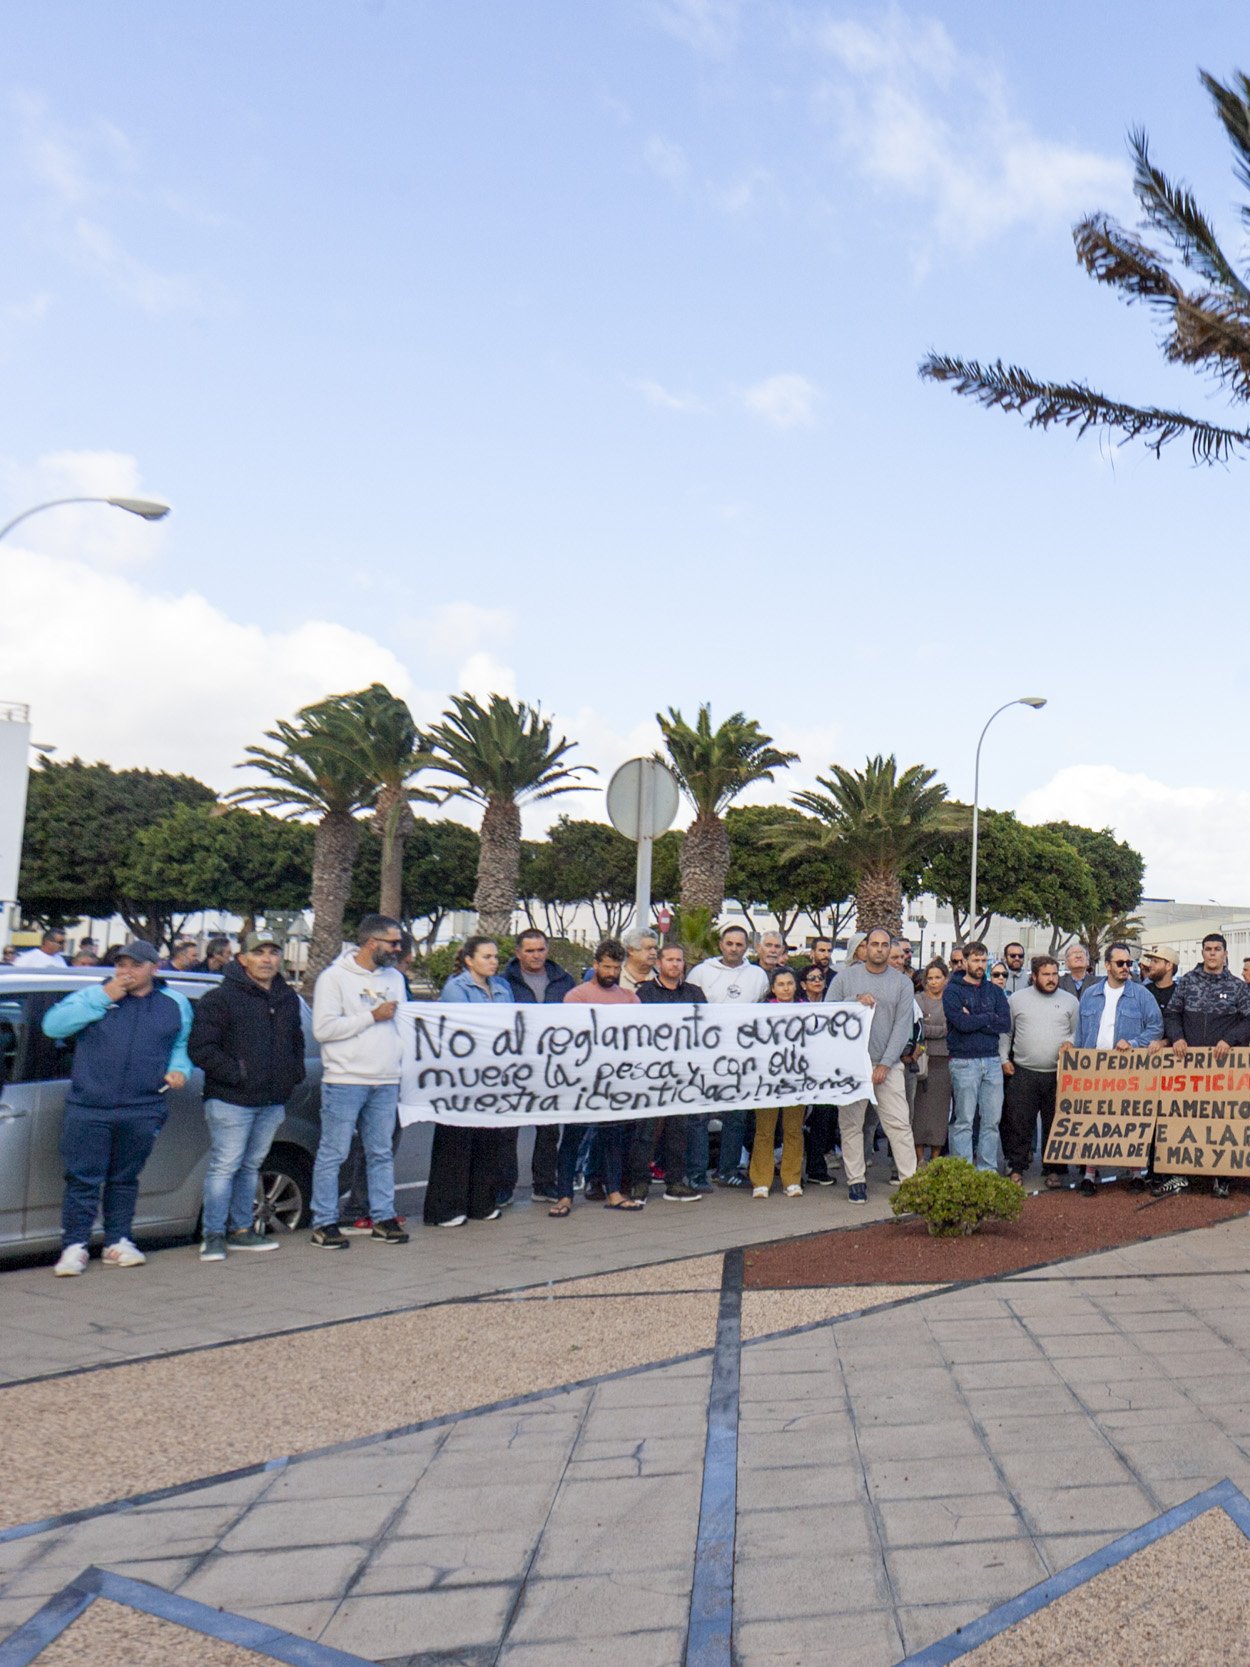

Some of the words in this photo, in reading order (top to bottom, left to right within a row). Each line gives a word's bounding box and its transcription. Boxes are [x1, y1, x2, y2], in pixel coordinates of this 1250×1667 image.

[415, 1015, 476, 1061] No
[493, 1010, 525, 1056] al
[537, 1004, 721, 1067] reglamento
[737, 1010, 863, 1048] europeo
[418, 1063, 533, 1090] muere
[545, 1054, 581, 1089] la
[593, 1060, 677, 1091] pesca
[429, 1087, 559, 1114] nuestra
[1059, 1098, 1092, 1115] QUE
[1097, 1100, 1116, 1115] EL
[1054, 1118, 1083, 1137] SE
[1178, 1125, 1197, 1143] A
[1206, 1125, 1239, 1146] LA
[1167, 1146, 1204, 1168] MAR
[1212, 1149, 1225, 1168] Y
